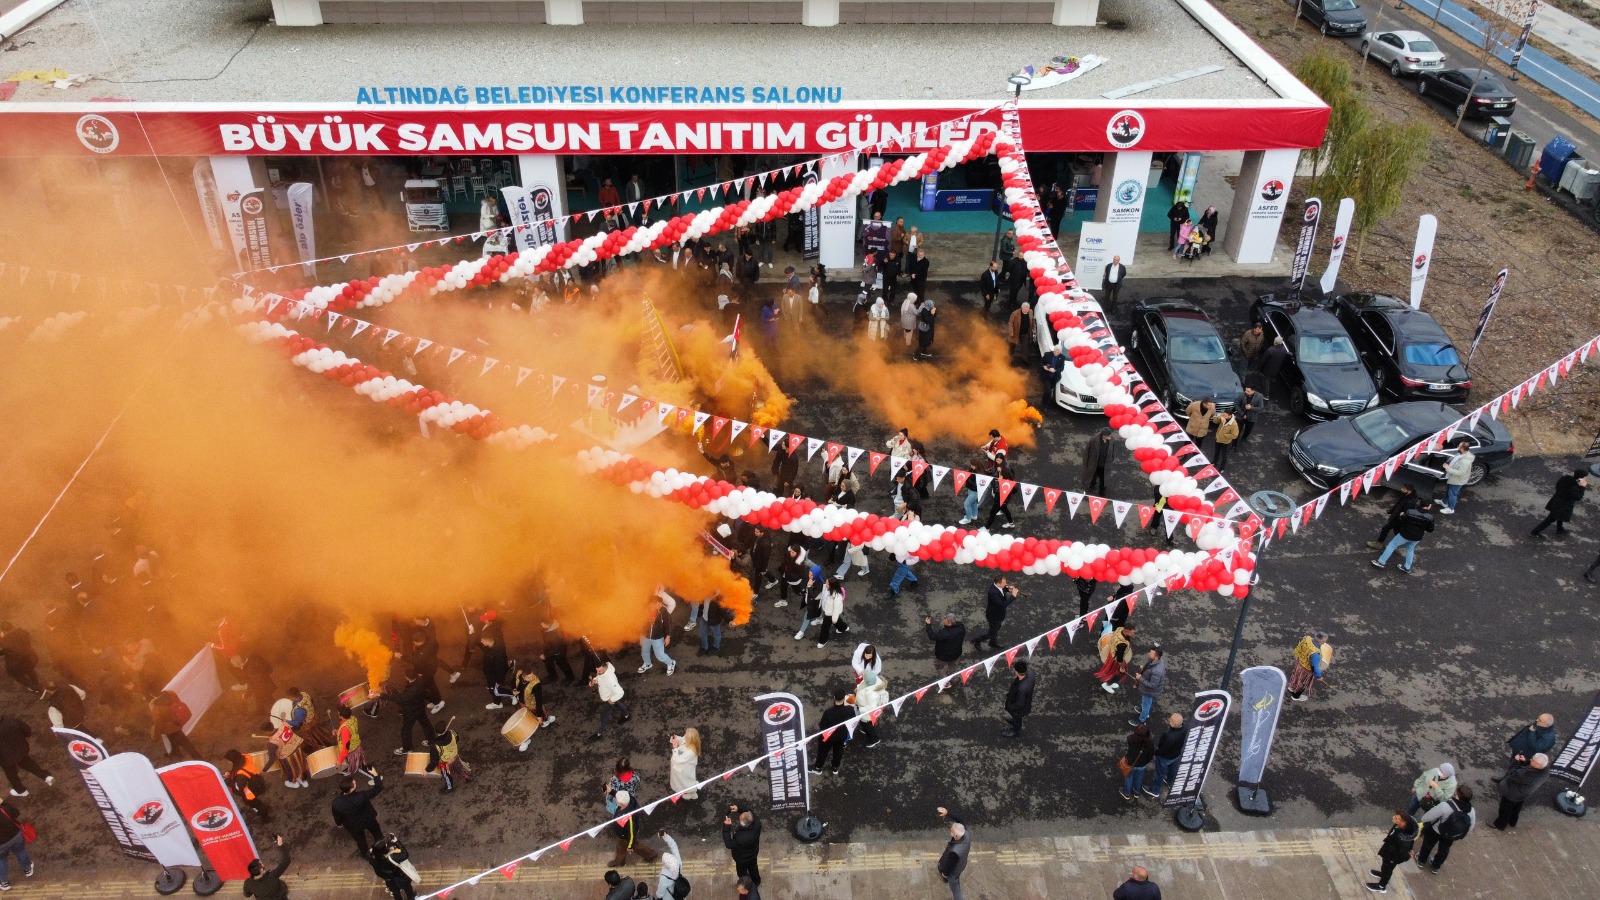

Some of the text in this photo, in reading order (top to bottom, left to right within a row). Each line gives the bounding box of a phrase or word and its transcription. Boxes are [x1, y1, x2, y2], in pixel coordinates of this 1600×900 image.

[356, 86, 469, 104] ALTINDAĞ
[610, 86, 745, 103] KONFERANS
[752, 86, 842, 103] SALONU
[219, 115, 390, 151] BÜYÜK
[397, 122, 600, 150] SAMSUN
[610, 122, 805, 149] TANITIM
